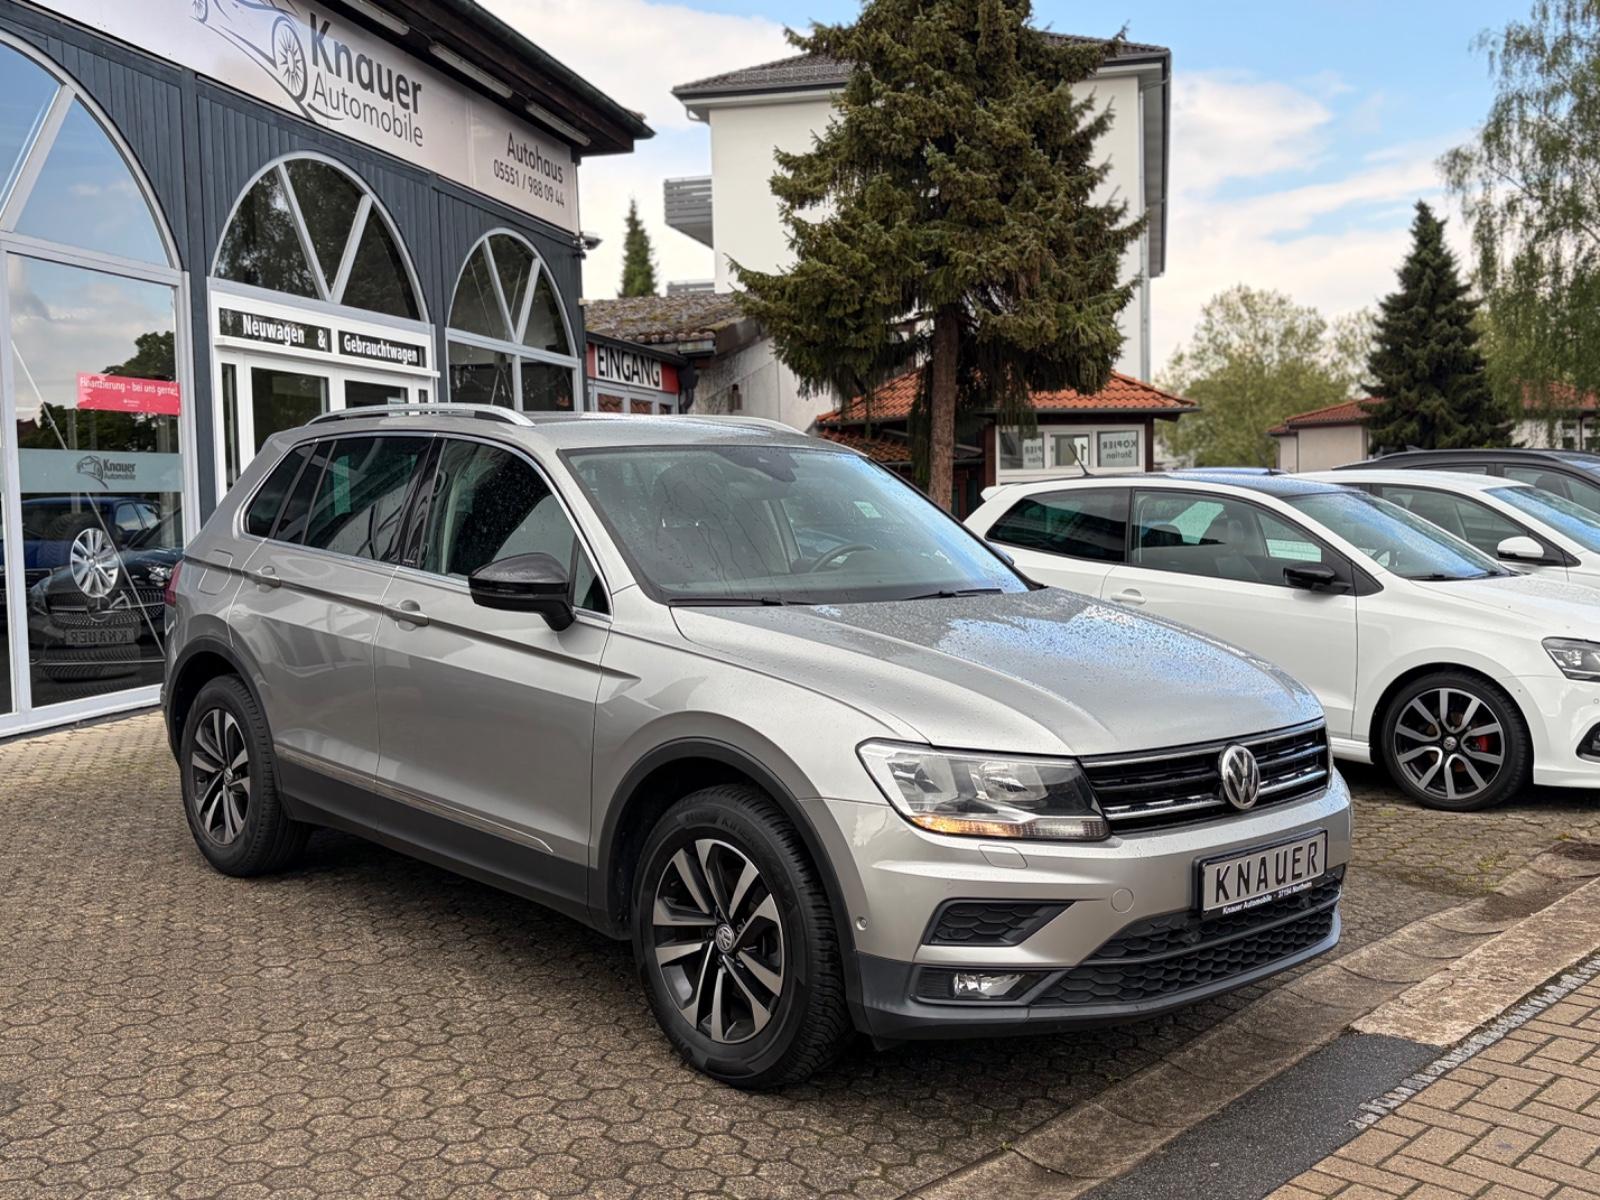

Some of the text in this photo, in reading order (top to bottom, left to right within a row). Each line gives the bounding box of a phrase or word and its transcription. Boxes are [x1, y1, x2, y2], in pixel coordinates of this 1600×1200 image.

[309, 12, 422, 115] Knauer
[312, 73, 424, 148] Automobile
[507, 131, 564, 184] Autohaus
[493, 159, 520, 188] 05551
[528, 176, 543, 199] 988
[544, 184, 554, 203] 09
[555, 190, 565, 208] 44
[242, 314, 418, 364] Neuwagen & Gebrauchtwagen
[80, 377, 125, 392] Finanzierung
[132, 382, 143, 392] bei
[144, 385, 156, 393] uns
[597, 344, 661, 388] EINGANG
[103, 459, 136, 472] Knauer
[103, 471, 136, 480] Automobile
[1215, 841, 1318, 903] KNAUER
[1222, 904, 1243, 915] Knauer
[1243, 894, 1273, 909] Automobile
